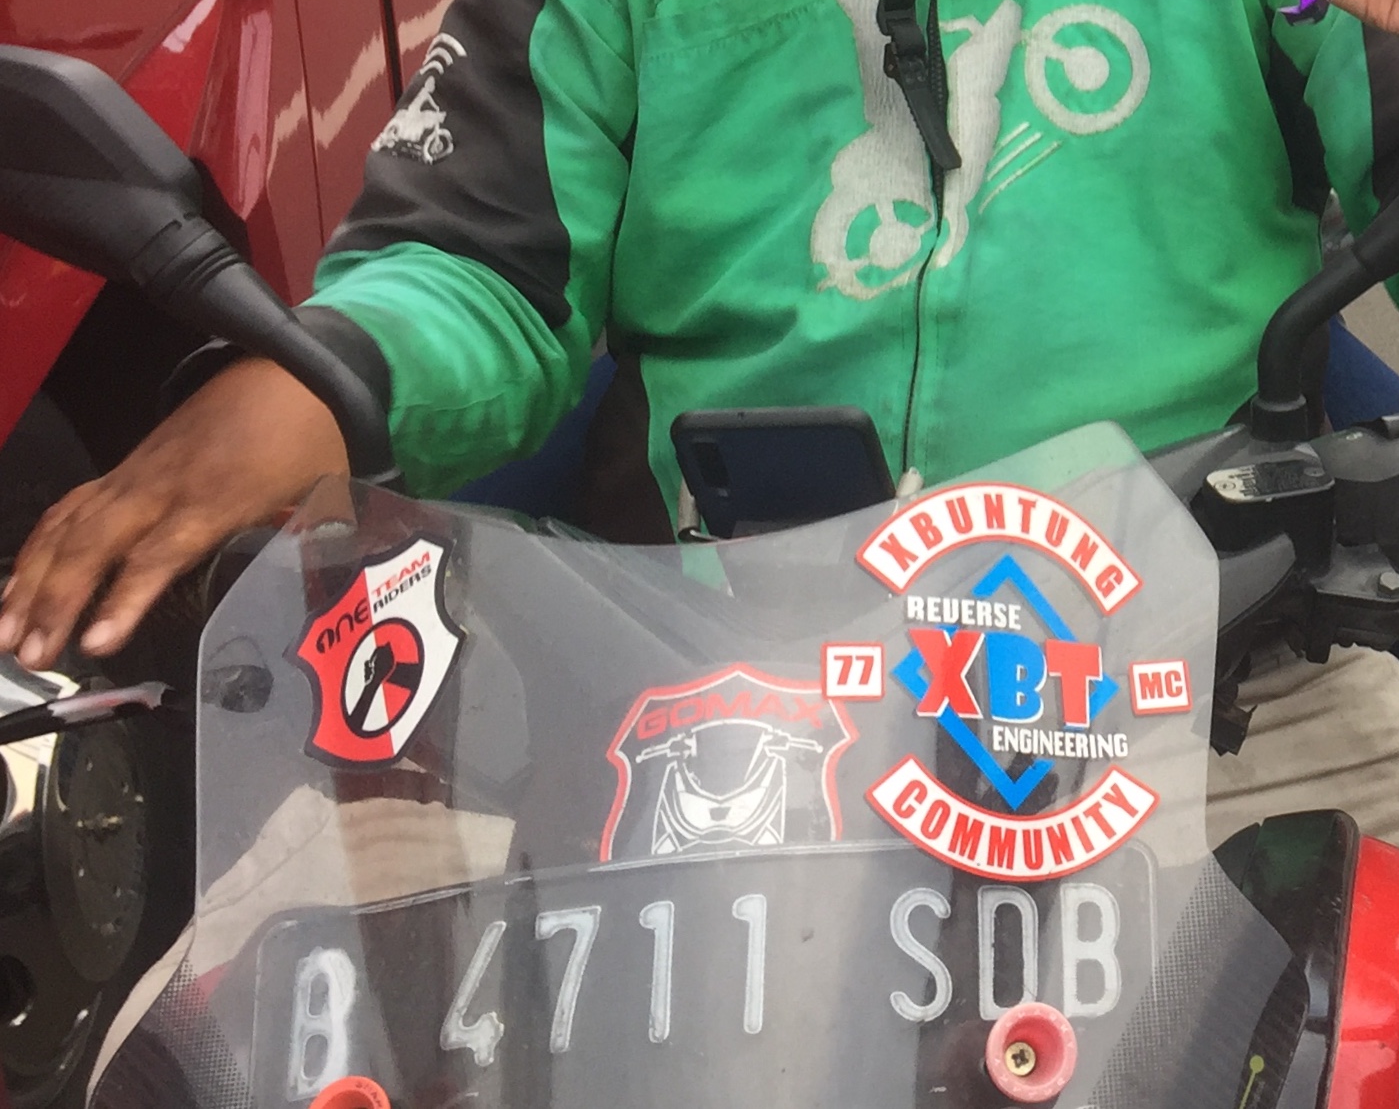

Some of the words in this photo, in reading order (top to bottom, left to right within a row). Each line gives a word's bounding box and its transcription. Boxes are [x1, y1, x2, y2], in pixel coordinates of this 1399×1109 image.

[879, 493, 1124, 599] XBUNTUNG
[372, 552, 431, 598] TEAM
[373, 564, 432, 614] RIDERS
[907, 595, 1021, 630] REVERSE
[833, 655, 875, 686] 77
[909, 628, 1103, 728] XBT
[1139, 670, 1183, 701] MC
[636, 691, 823, 740] GOMAX
[992, 725, 1129, 759] ENGINEERING
[891, 779, 1139, 871] COMMUNITY
[440, 894, 769, 1066] 4711
[890, 882, 1122, 1022] SDB
